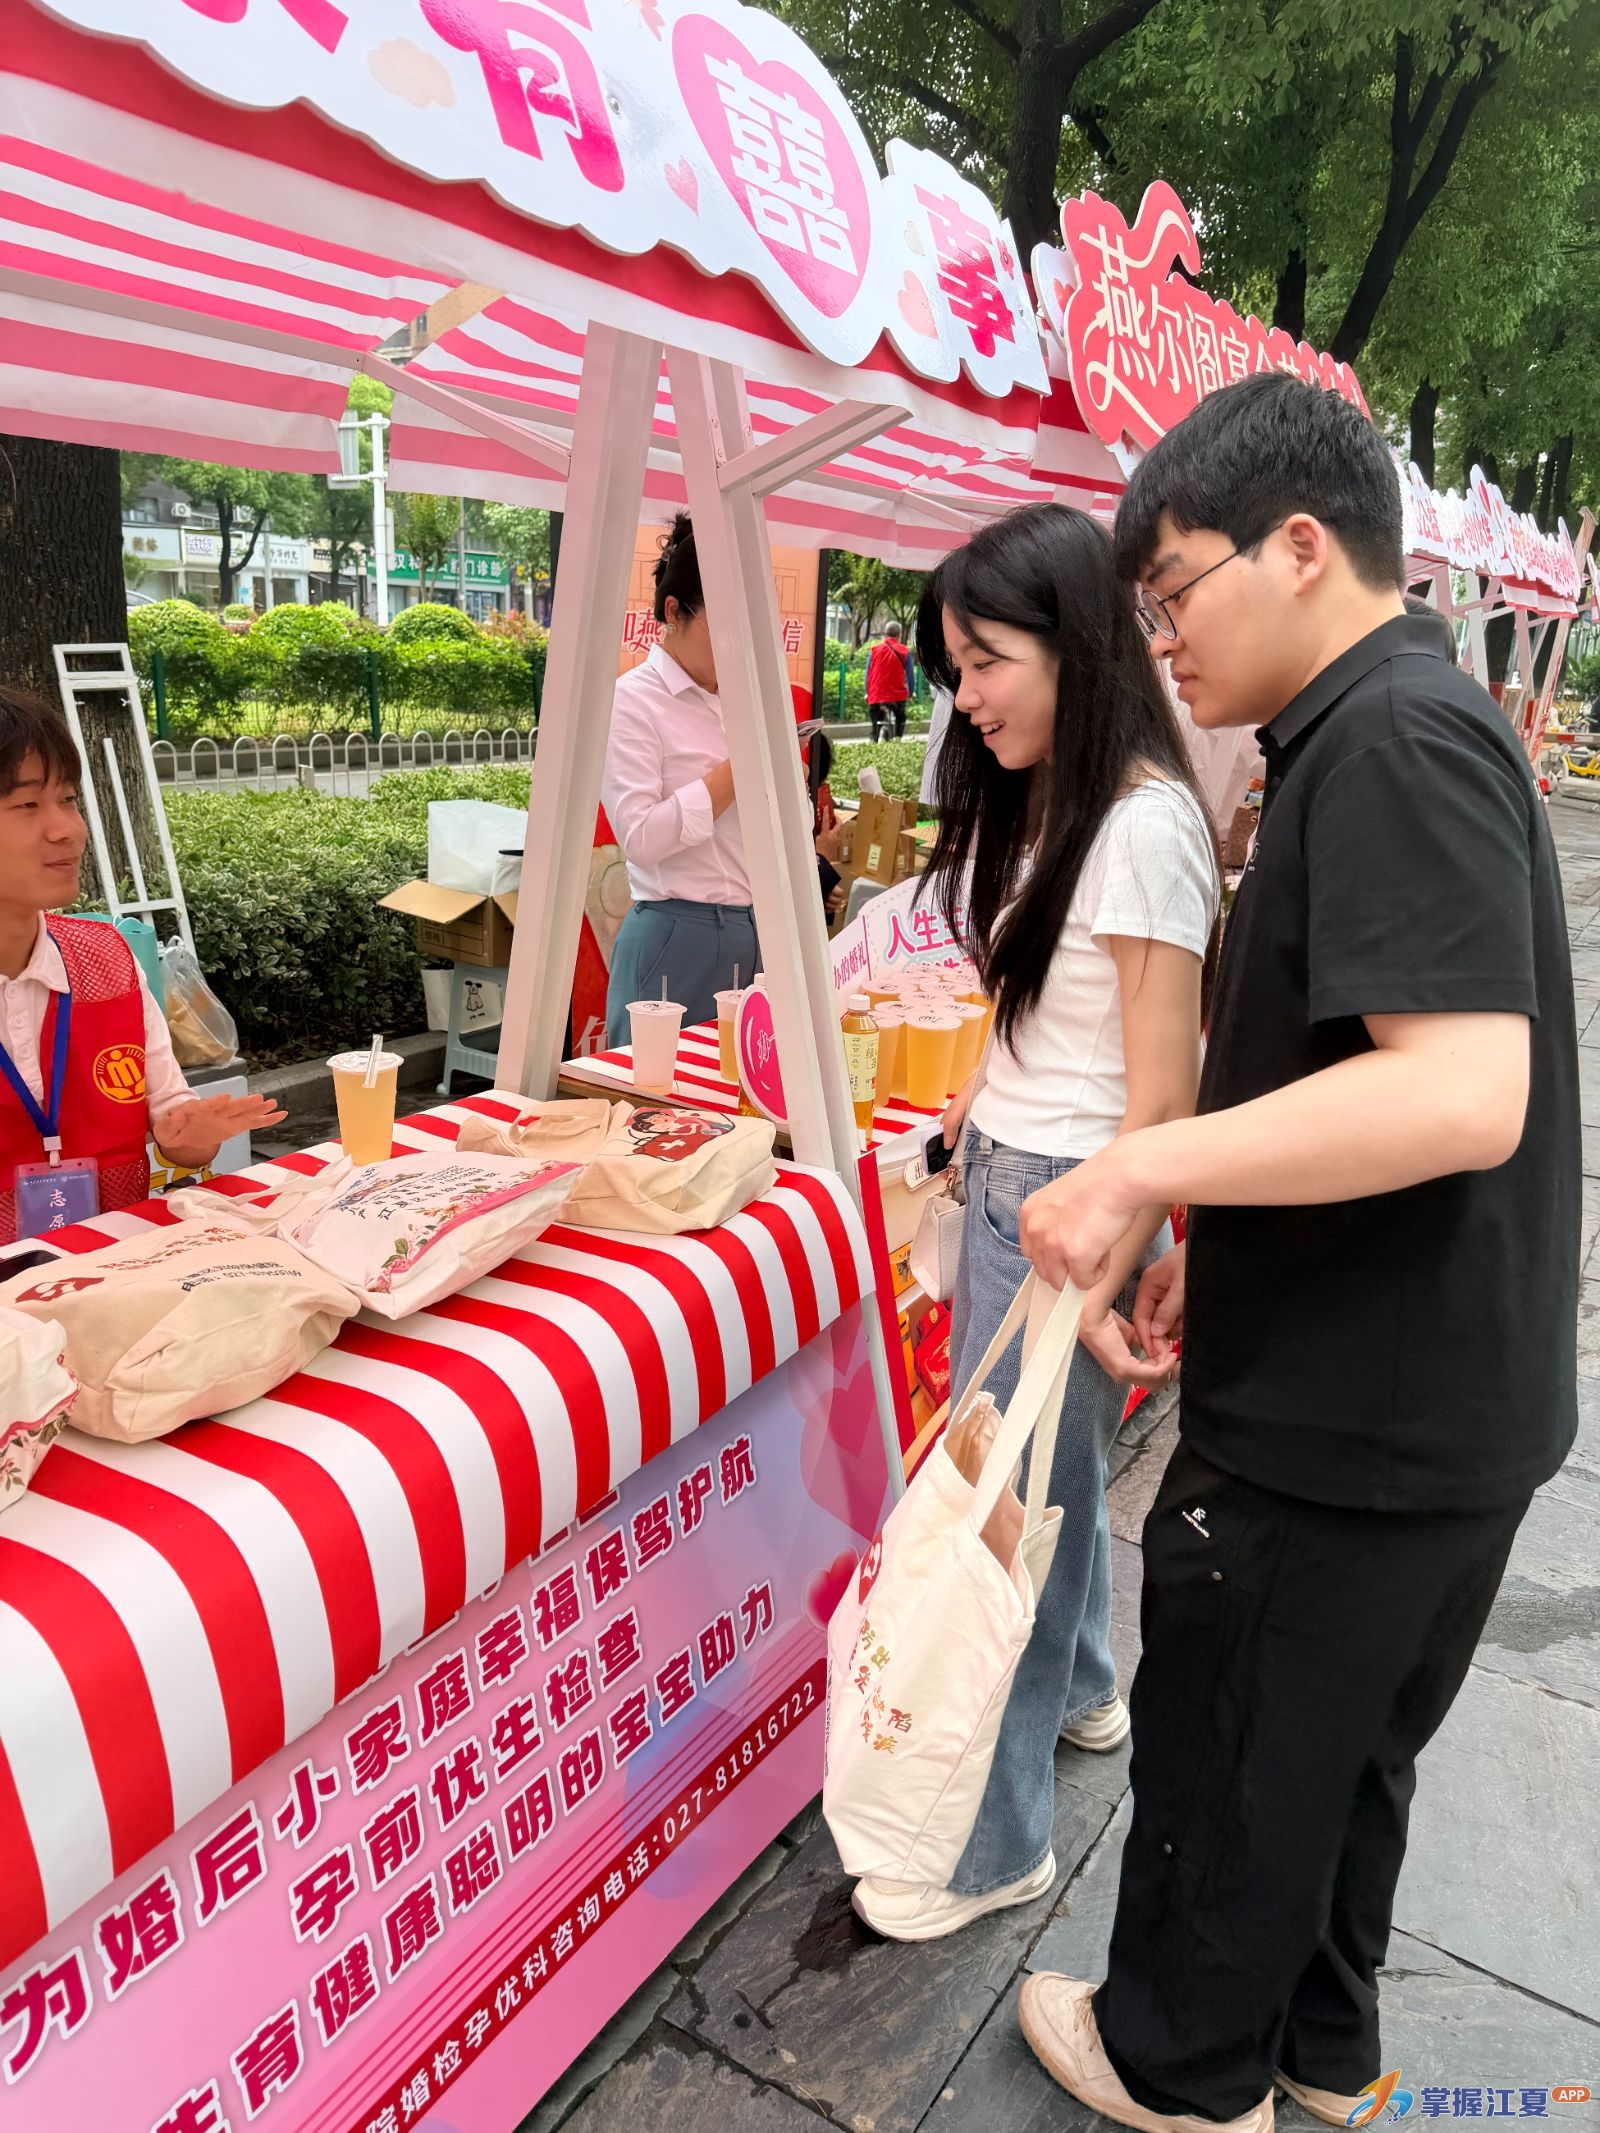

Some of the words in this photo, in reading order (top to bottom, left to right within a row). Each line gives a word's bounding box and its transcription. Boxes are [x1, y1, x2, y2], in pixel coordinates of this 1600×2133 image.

[181, 0, 1017, 357] 有囍事
[888, 907, 970, 959] 人生三
[0, 1436, 756, 2077] 为婚后小家庭幸福保驾护航
[293, 1611, 642, 1938] 孕前优生检查
